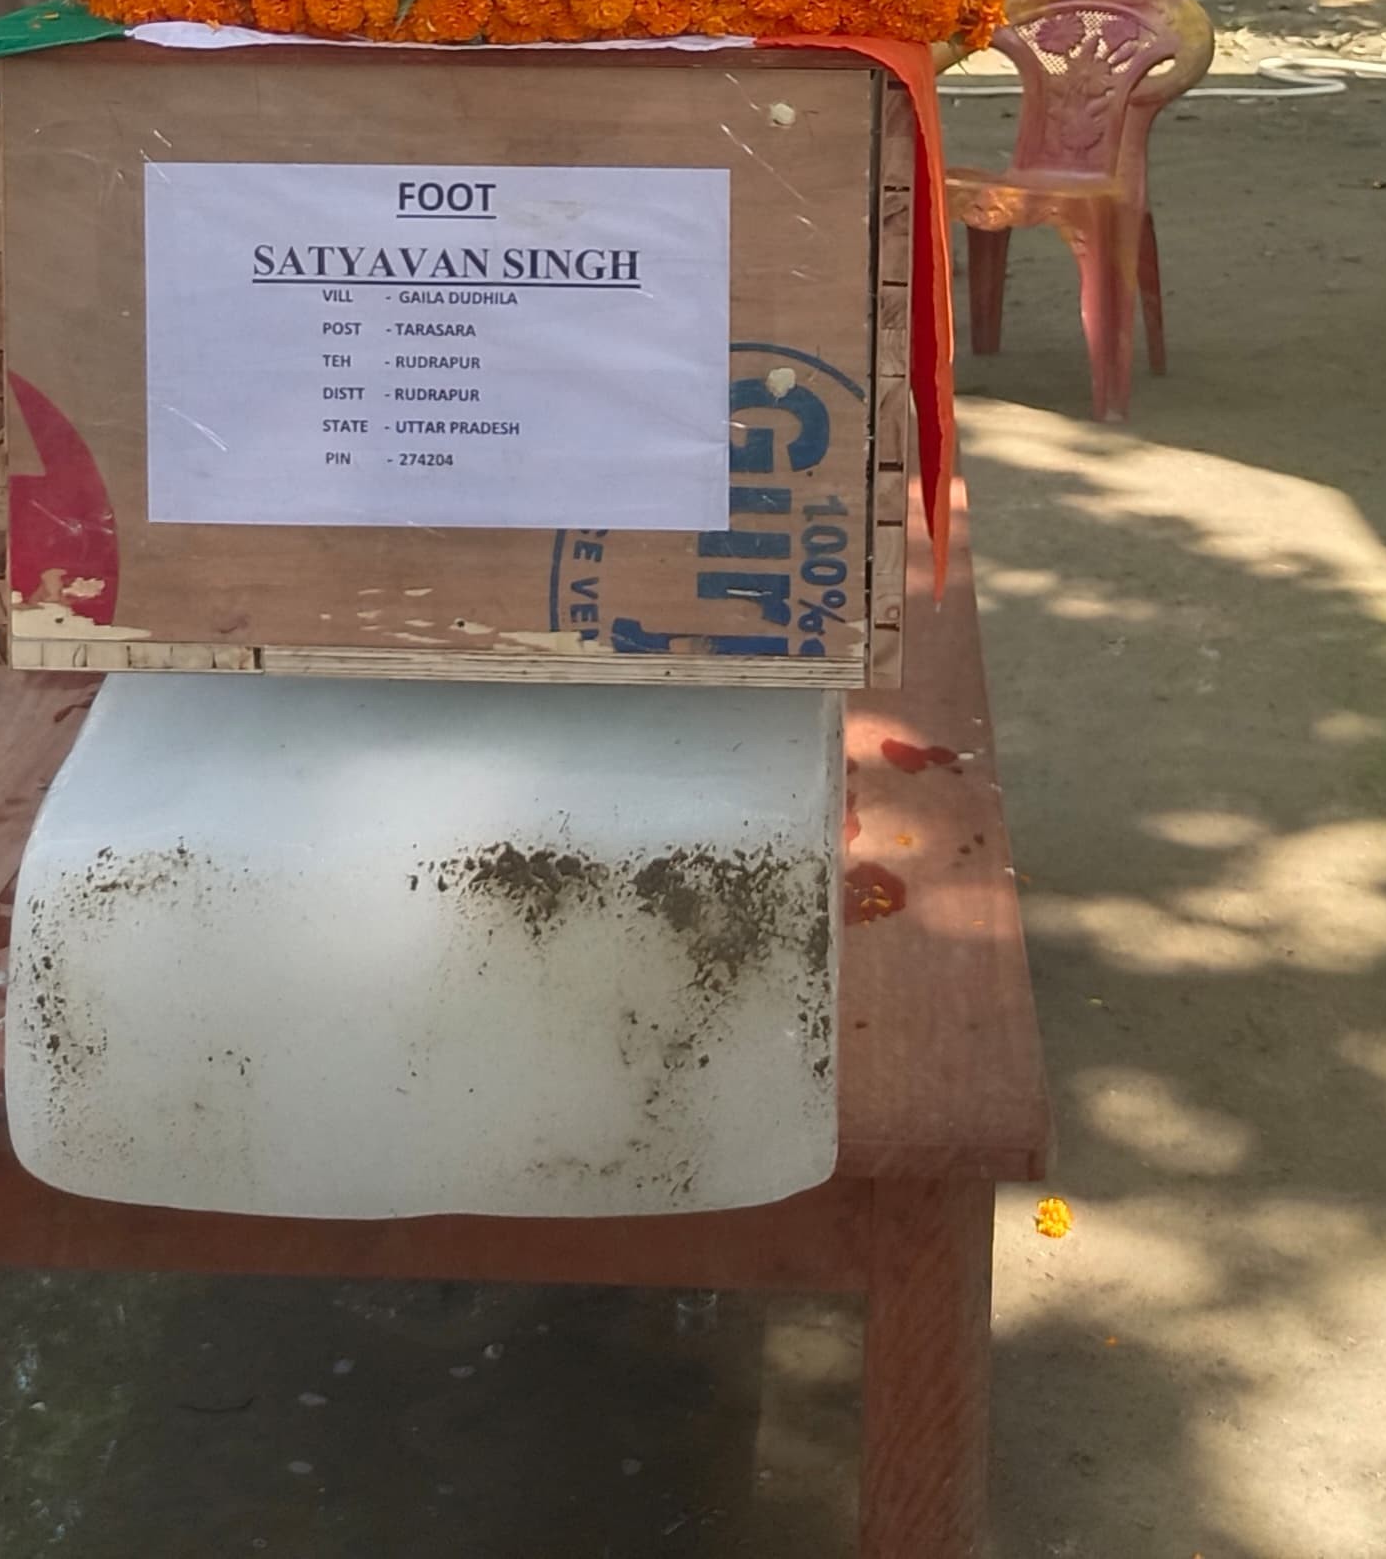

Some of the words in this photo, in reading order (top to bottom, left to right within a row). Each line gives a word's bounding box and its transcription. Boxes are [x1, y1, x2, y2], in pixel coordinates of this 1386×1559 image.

[397, 182, 496, 212] FOOT
[252, 245, 489, 279] SATYAVAN
[503, 249, 640, 281] SINGH
[322, 289, 354, 303] VILL
[398, 290, 445, 305] GAILA
[449, 291, 518, 305] DUDHILA
[322, 321, 362, 336] POST
[394, 322, 477, 337] TARASARA
[322, 353, 351, 368] TEH
[395, 355, 481, 370] RUDRAPUR
[322, 386, 366, 401] DISTT
[395, 387, 480, 402] RUDRAPUR
[322, 419, 369, 434] STATE
[395, 420, 446, 435] UTTAR
[449, 420, 520, 436] PRADESH
[325, 451, 351, 465] PIN
[399, 453, 454, 467] 274204
